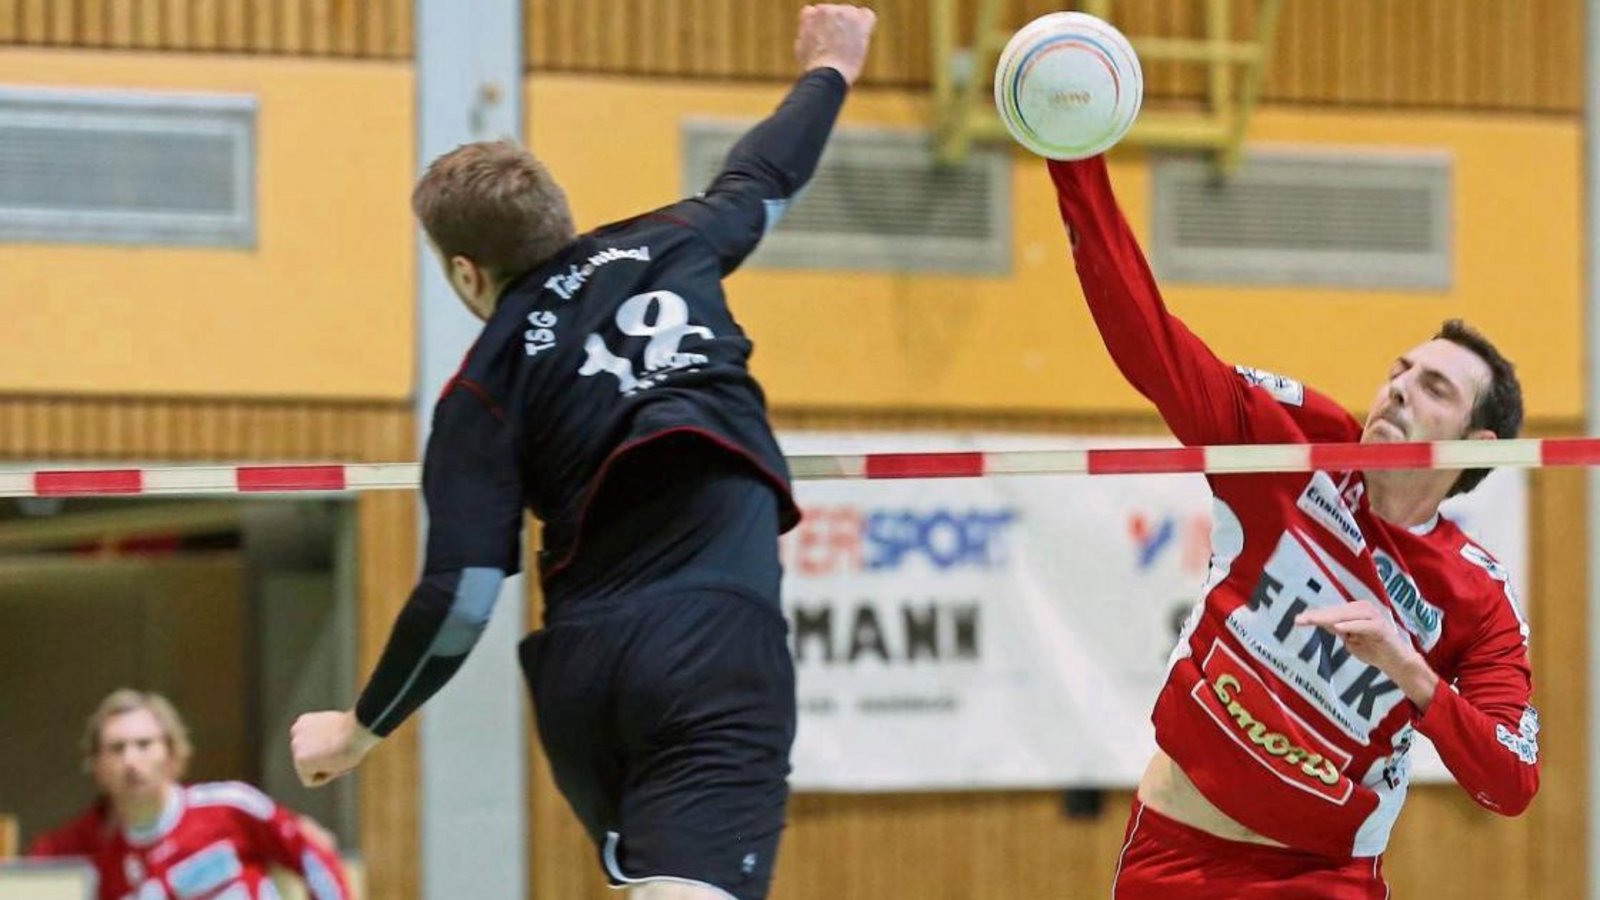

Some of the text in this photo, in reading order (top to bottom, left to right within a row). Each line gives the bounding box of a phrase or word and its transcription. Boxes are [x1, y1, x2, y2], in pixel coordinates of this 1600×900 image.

[525, 311, 558, 356] TSG
[781, 507, 1016, 574] ERSPORT
[1306, 486, 1362, 543] Ensinger
